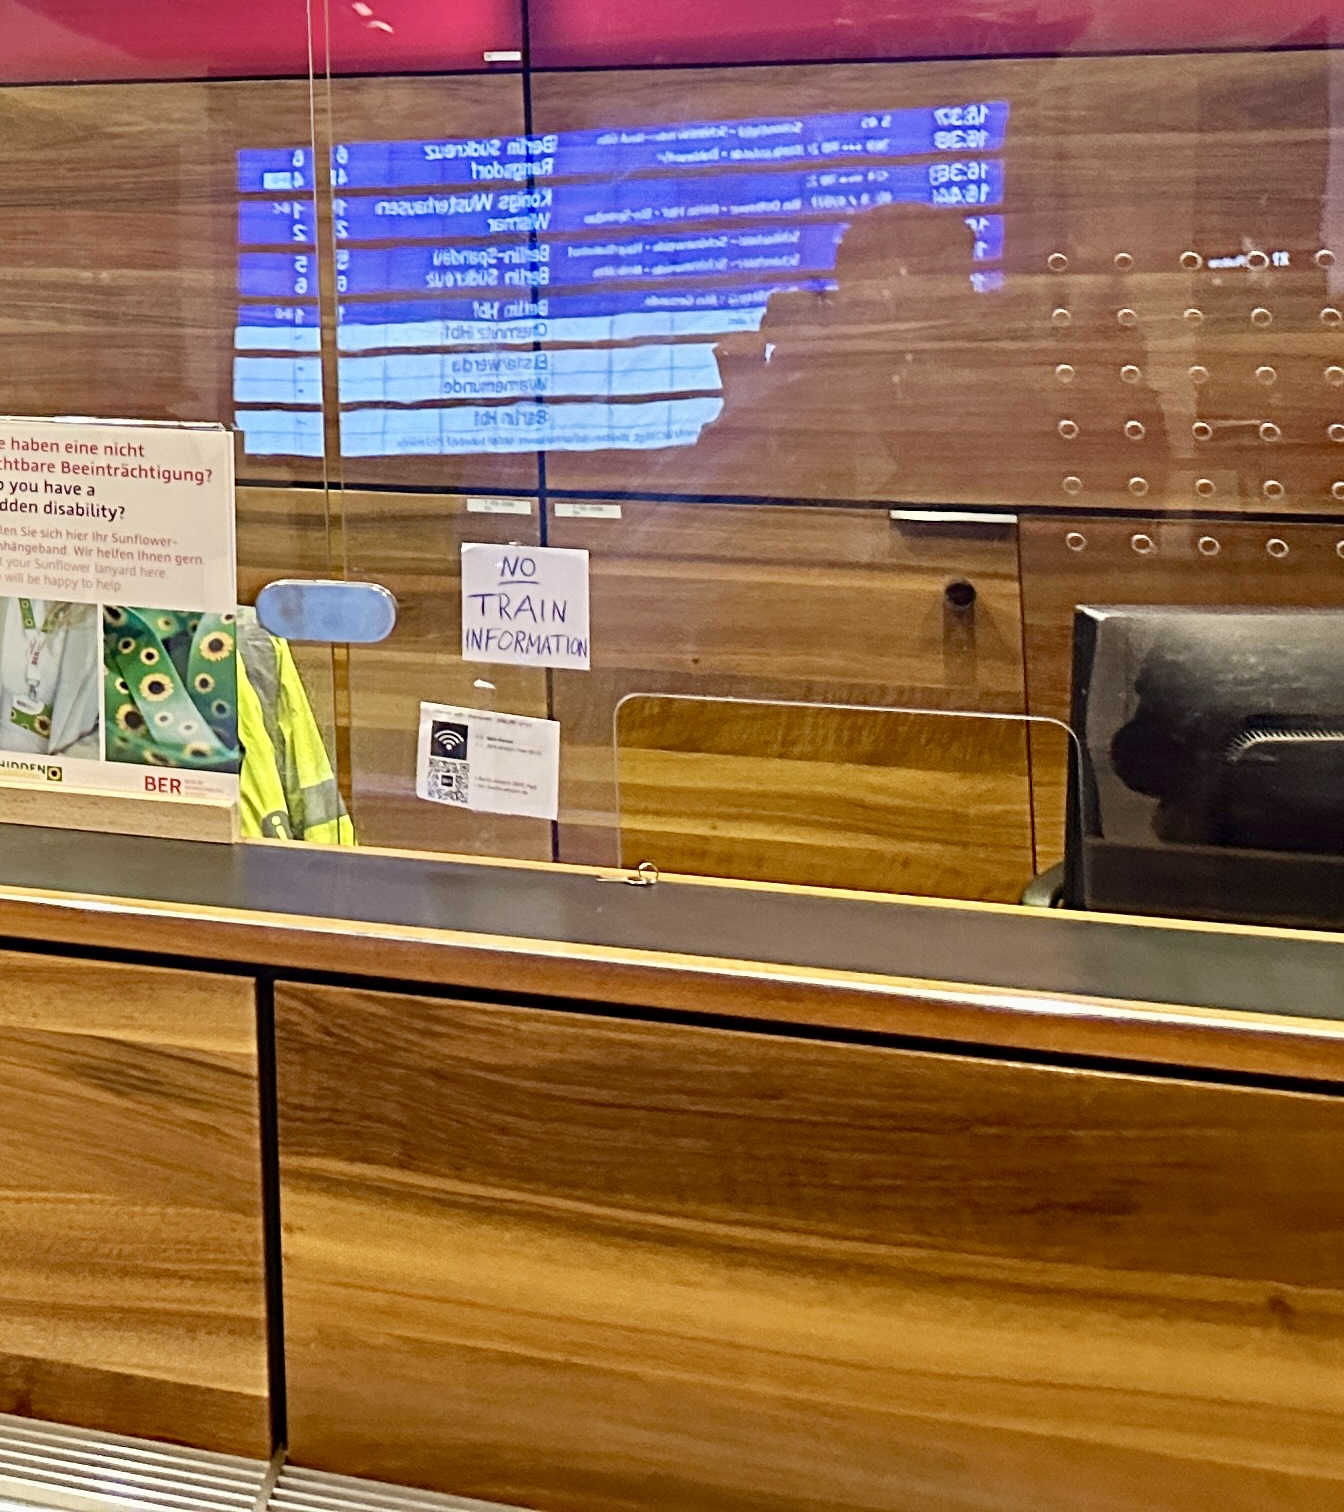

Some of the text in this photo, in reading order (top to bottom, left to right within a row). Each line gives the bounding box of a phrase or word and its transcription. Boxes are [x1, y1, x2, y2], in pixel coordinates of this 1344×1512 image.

[11, 436, 59, 453] haben
[65, 440, 98, 455] eine
[104, 442, 144, 457] nicht
[61, 460, 212, 485] Beeinträchtigung?
[9, 480, 38, 495] you
[44, 479, 82, 496] have
[87, 486, 95, 496] a
[43, 500, 125, 522] disability?
[20, 526, 37, 538] Sie
[40, 528, 62, 539] sich
[66, 529, 88, 541] hier
[92, 531, 108, 542] Ihr
[112, 533, 178, 547] Sunflower-
[73, 546, 93, 557] Wir
[96, 547, 134, 560] helfen
[137, 550, 171, 563] Ihnen
[6, 558, 31, 569] your
[35, 558, 90, 573] Sunflower
[94, 563, 136, 577] lanyard
[499, 555, 537, 578] NO
[4, 572, 24, 584] will
[27, 573, 40, 584] be
[44, 575, 78, 590] happy
[81, 578, 93, 589] to
[467, 593, 568, 623] TRAIN
[465, 627, 588, 658] INFORMATION
[144, 775, 182, 794] BER
